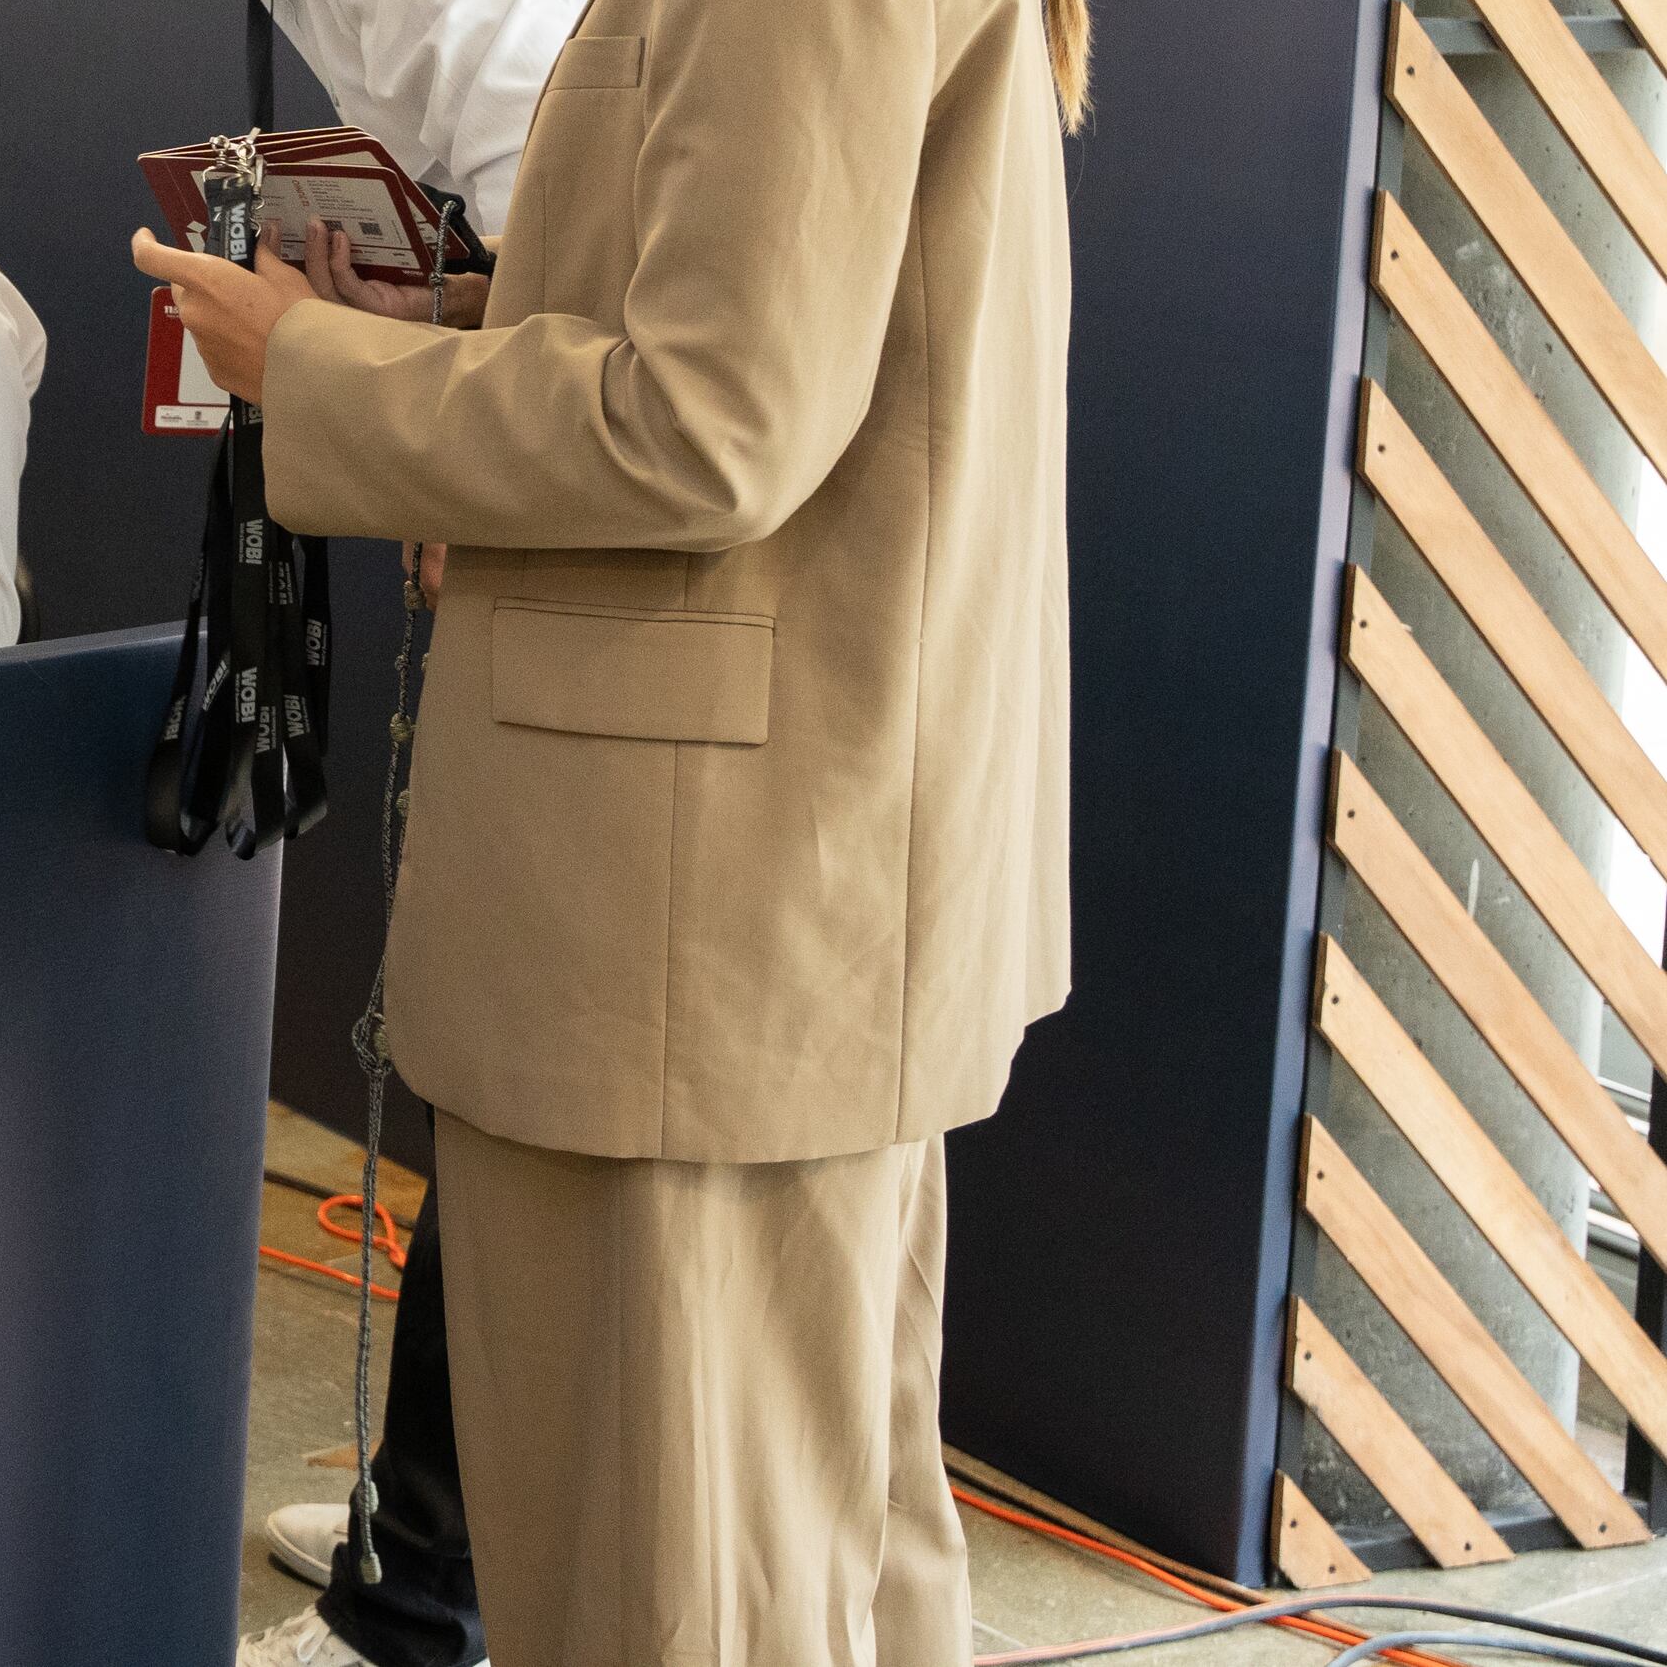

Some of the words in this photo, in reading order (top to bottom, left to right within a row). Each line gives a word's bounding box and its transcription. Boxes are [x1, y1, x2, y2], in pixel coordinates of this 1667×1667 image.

[230, 202, 248, 262] WOBI
[246, 518, 264, 565] WOBI
[306, 618, 322, 666] WOBI
[241, 666, 258, 723] WOBI
[283, 694, 305, 738] WOBI
